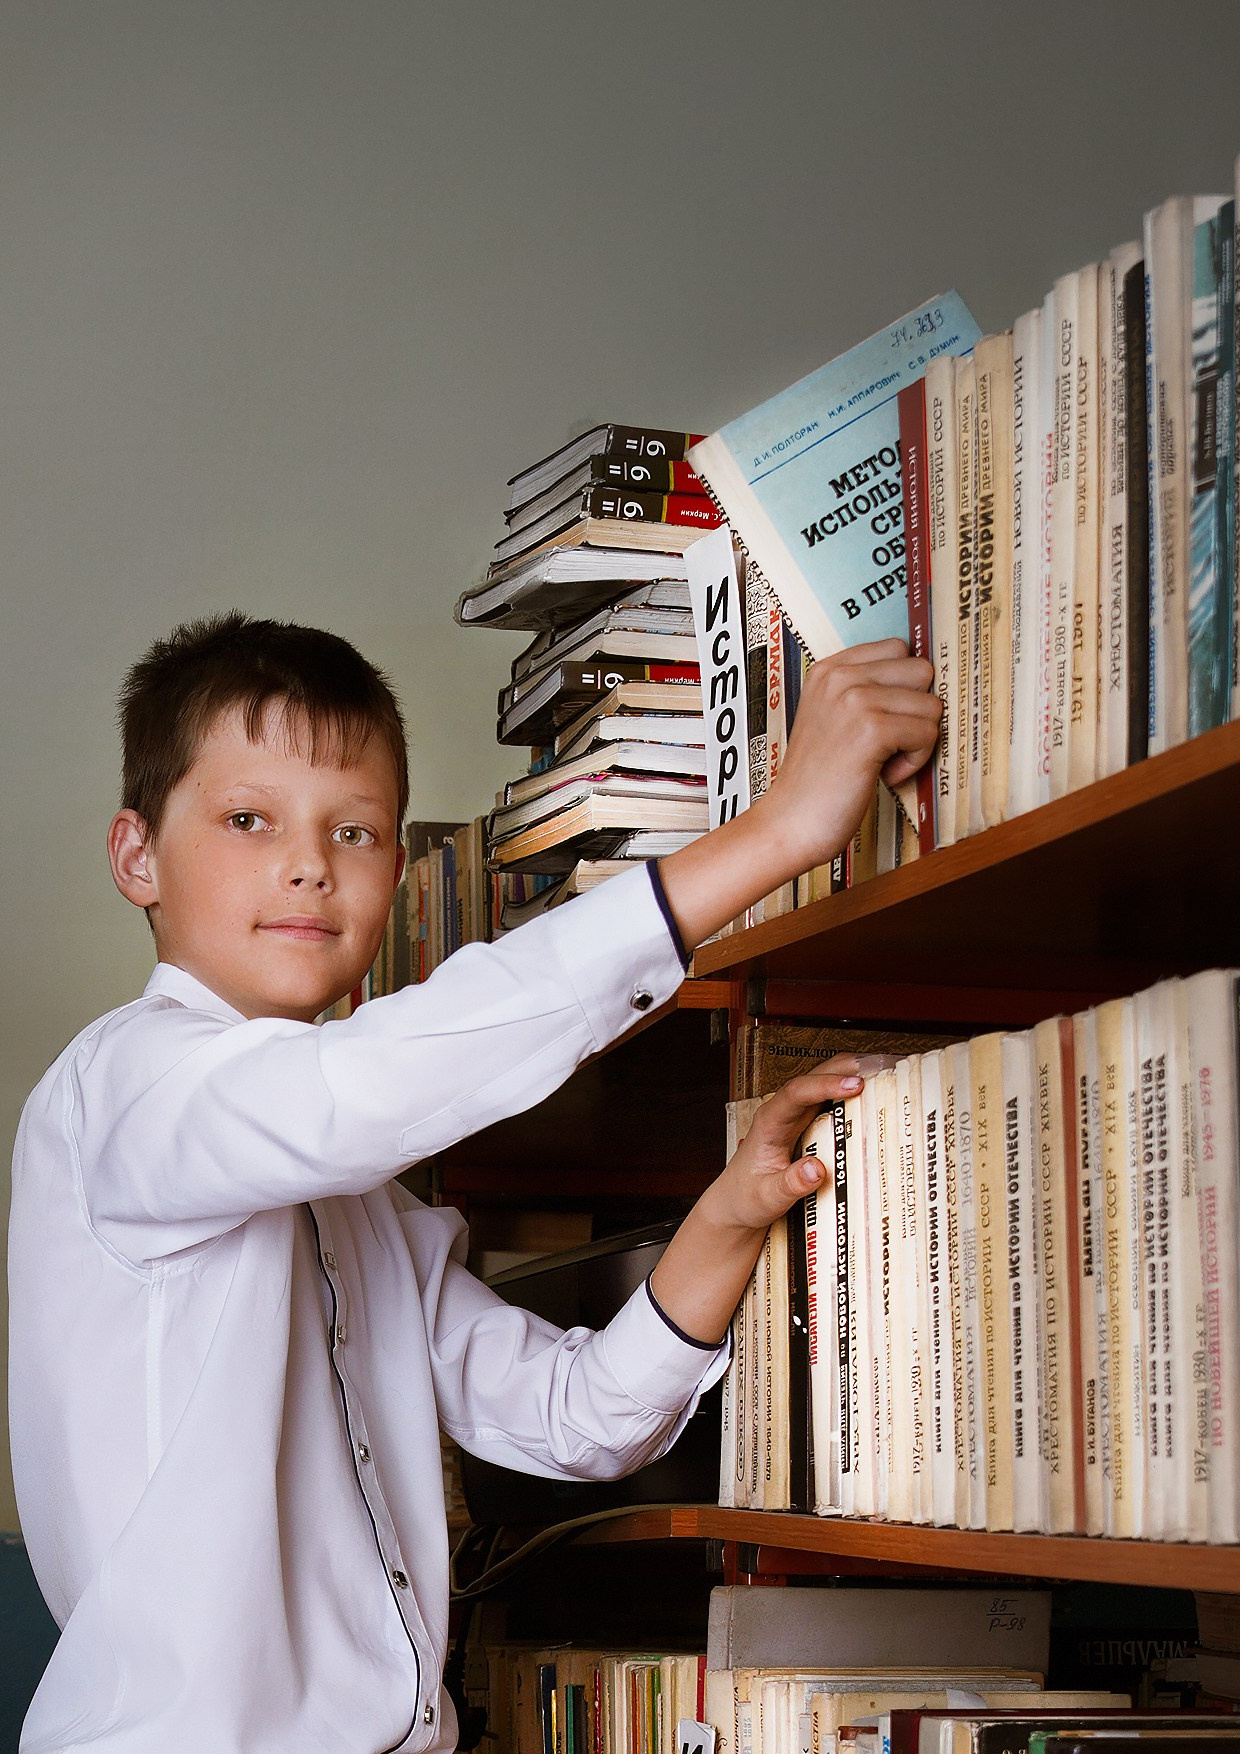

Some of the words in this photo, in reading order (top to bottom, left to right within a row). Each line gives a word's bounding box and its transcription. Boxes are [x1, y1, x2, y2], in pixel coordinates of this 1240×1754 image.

[933, 397, 943, 442] СССР
[962, 396, 970, 434] МИРА
[979, 374, 988, 414] МИРА
[1013, 355, 1023, 464] ИСТОРИИ
[961, 440, 970, 509] ДРЕВНЕГО
[980, 420, 990, 490] ДРЕВНЕГО
[680, 509, 710, 520] Меркин
[800, 472, 902, 548] ИСПОЛЬ
[909, 446, 919, 530] ИСТОРИЯ
[934, 448, 946, 527] ИСТОРИИ
[911, 536, 921, 608] РОССИИ
[959, 513, 972, 619] ИСТОРИИ
[979, 493, 994, 606] ИСТОРИИ
[841, 599, 862, 621] В
[861, 563, 909, 605] ПРЕ
[982, 607, 989, 628] ПО
[1109, 524, 1122, 694] ХРЕСТОМАТИЯ
[960, 624, 968, 641] ПО
[959, 650, 968, 703] ЧТЕНИЯ
[982, 634, 990, 689] ЧТЕНИЯ
[704, 576, 739, 826] Истори
[959, 710, 967, 737] ДЛЯ
[982, 695, 990, 724] ДЛЯ
[959, 744, 967, 789] КНИГА
[926, 1109, 937, 1201] ОТЕЧЕСТВА
[978, 1118, 988, 1152] XIX
[1042, 1143, 1051, 1192] СССР
[980, 1183, 990, 1228] СССР
[928, 1206, 939, 1283] ИСТОРИИ
[1043, 1200, 1055, 1290] ИСТОРИИ
[1204, 1185, 1219, 1285] ИСТОРИИ
[933, 1286, 940, 1305] по
[982, 1236, 993, 1323] ИСТОРИИ
[933, 1309, 941, 1365] чтения
[985, 1327, 993, 1343] по
[1046, 1298, 1056, 1324] ПО
[985, 1346, 994, 1401] чтения
[1205, 1289, 1222, 1411] НОВЕЙШЕЙ
[934, 1406, 942, 1453] книга
[986, 1405, 996, 1435] для
[1047, 1332, 1060, 1474] ХРЕСТОМАТИЯ
[1211, 1418, 1223, 1447] ПО
[986, 1439, 996, 1486] Книга
